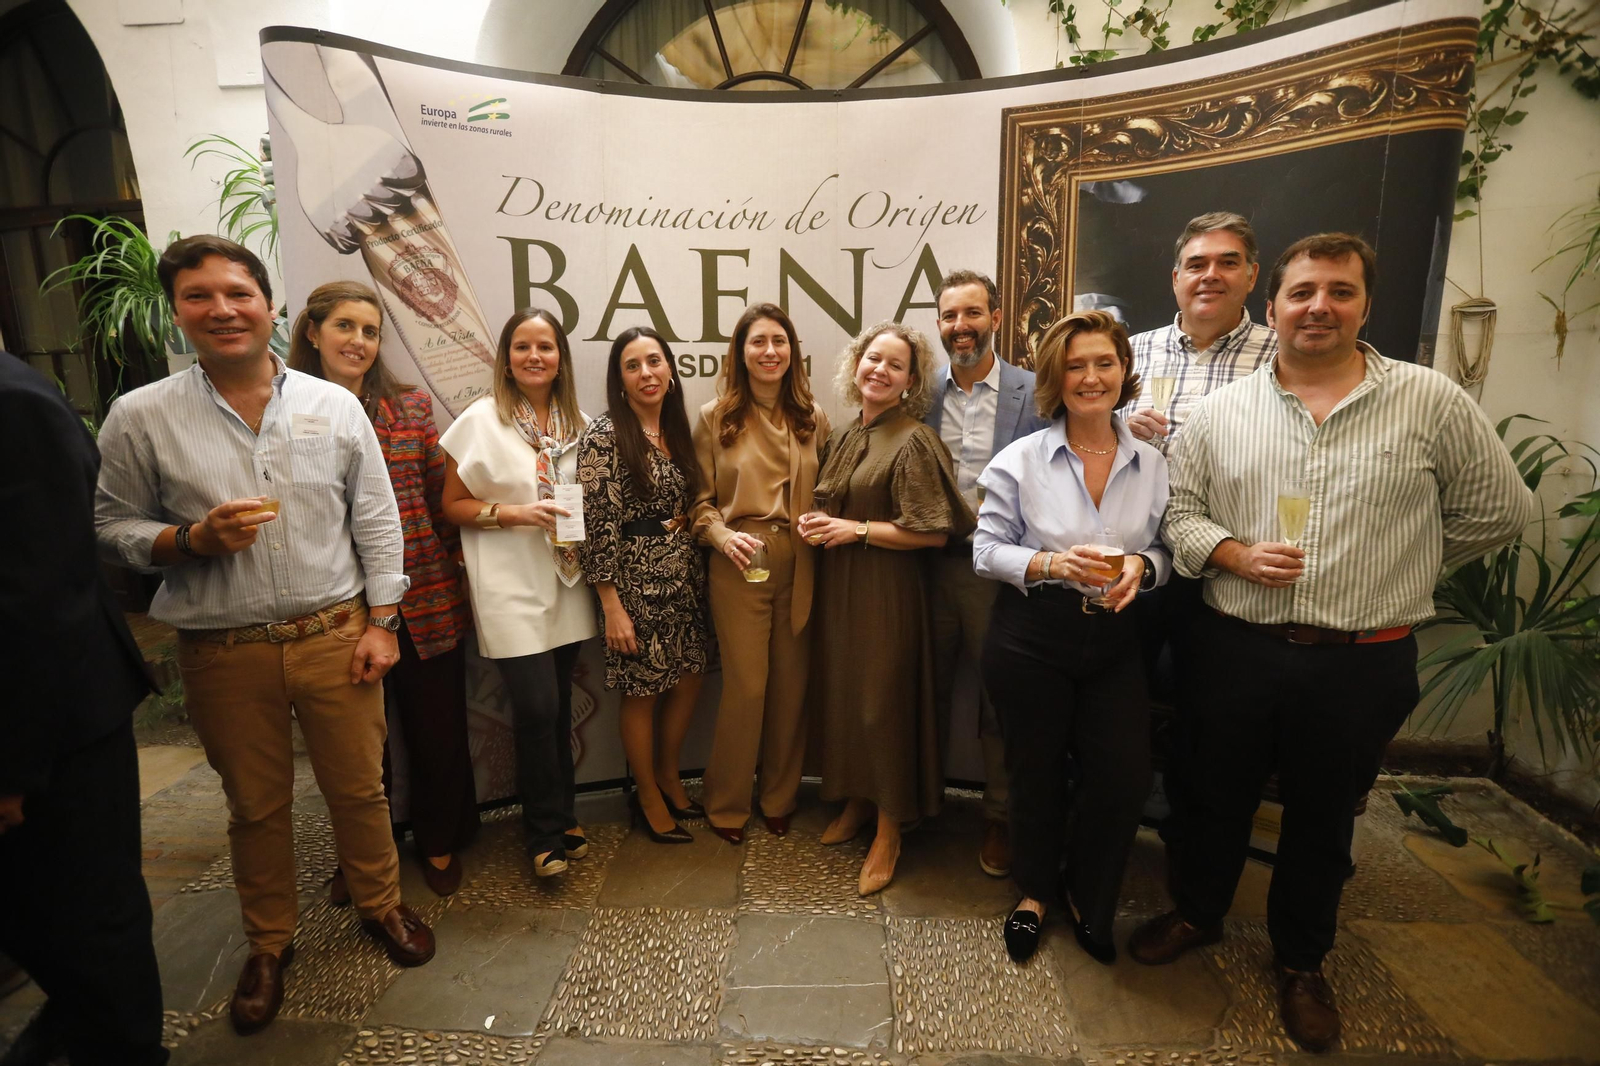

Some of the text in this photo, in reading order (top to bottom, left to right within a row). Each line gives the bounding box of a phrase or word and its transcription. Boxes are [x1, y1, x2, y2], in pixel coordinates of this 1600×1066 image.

[420, 104, 457, 120] Europa
[421, 118, 447, 129] invierte
[458, 122, 468, 131] las
[469, 126, 489, 134] zonas
[489, 129, 512, 138] rurales
[495, 174, 987, 269] Denominación de Origen
[365, 219, 444, 250] Producto Certificado
